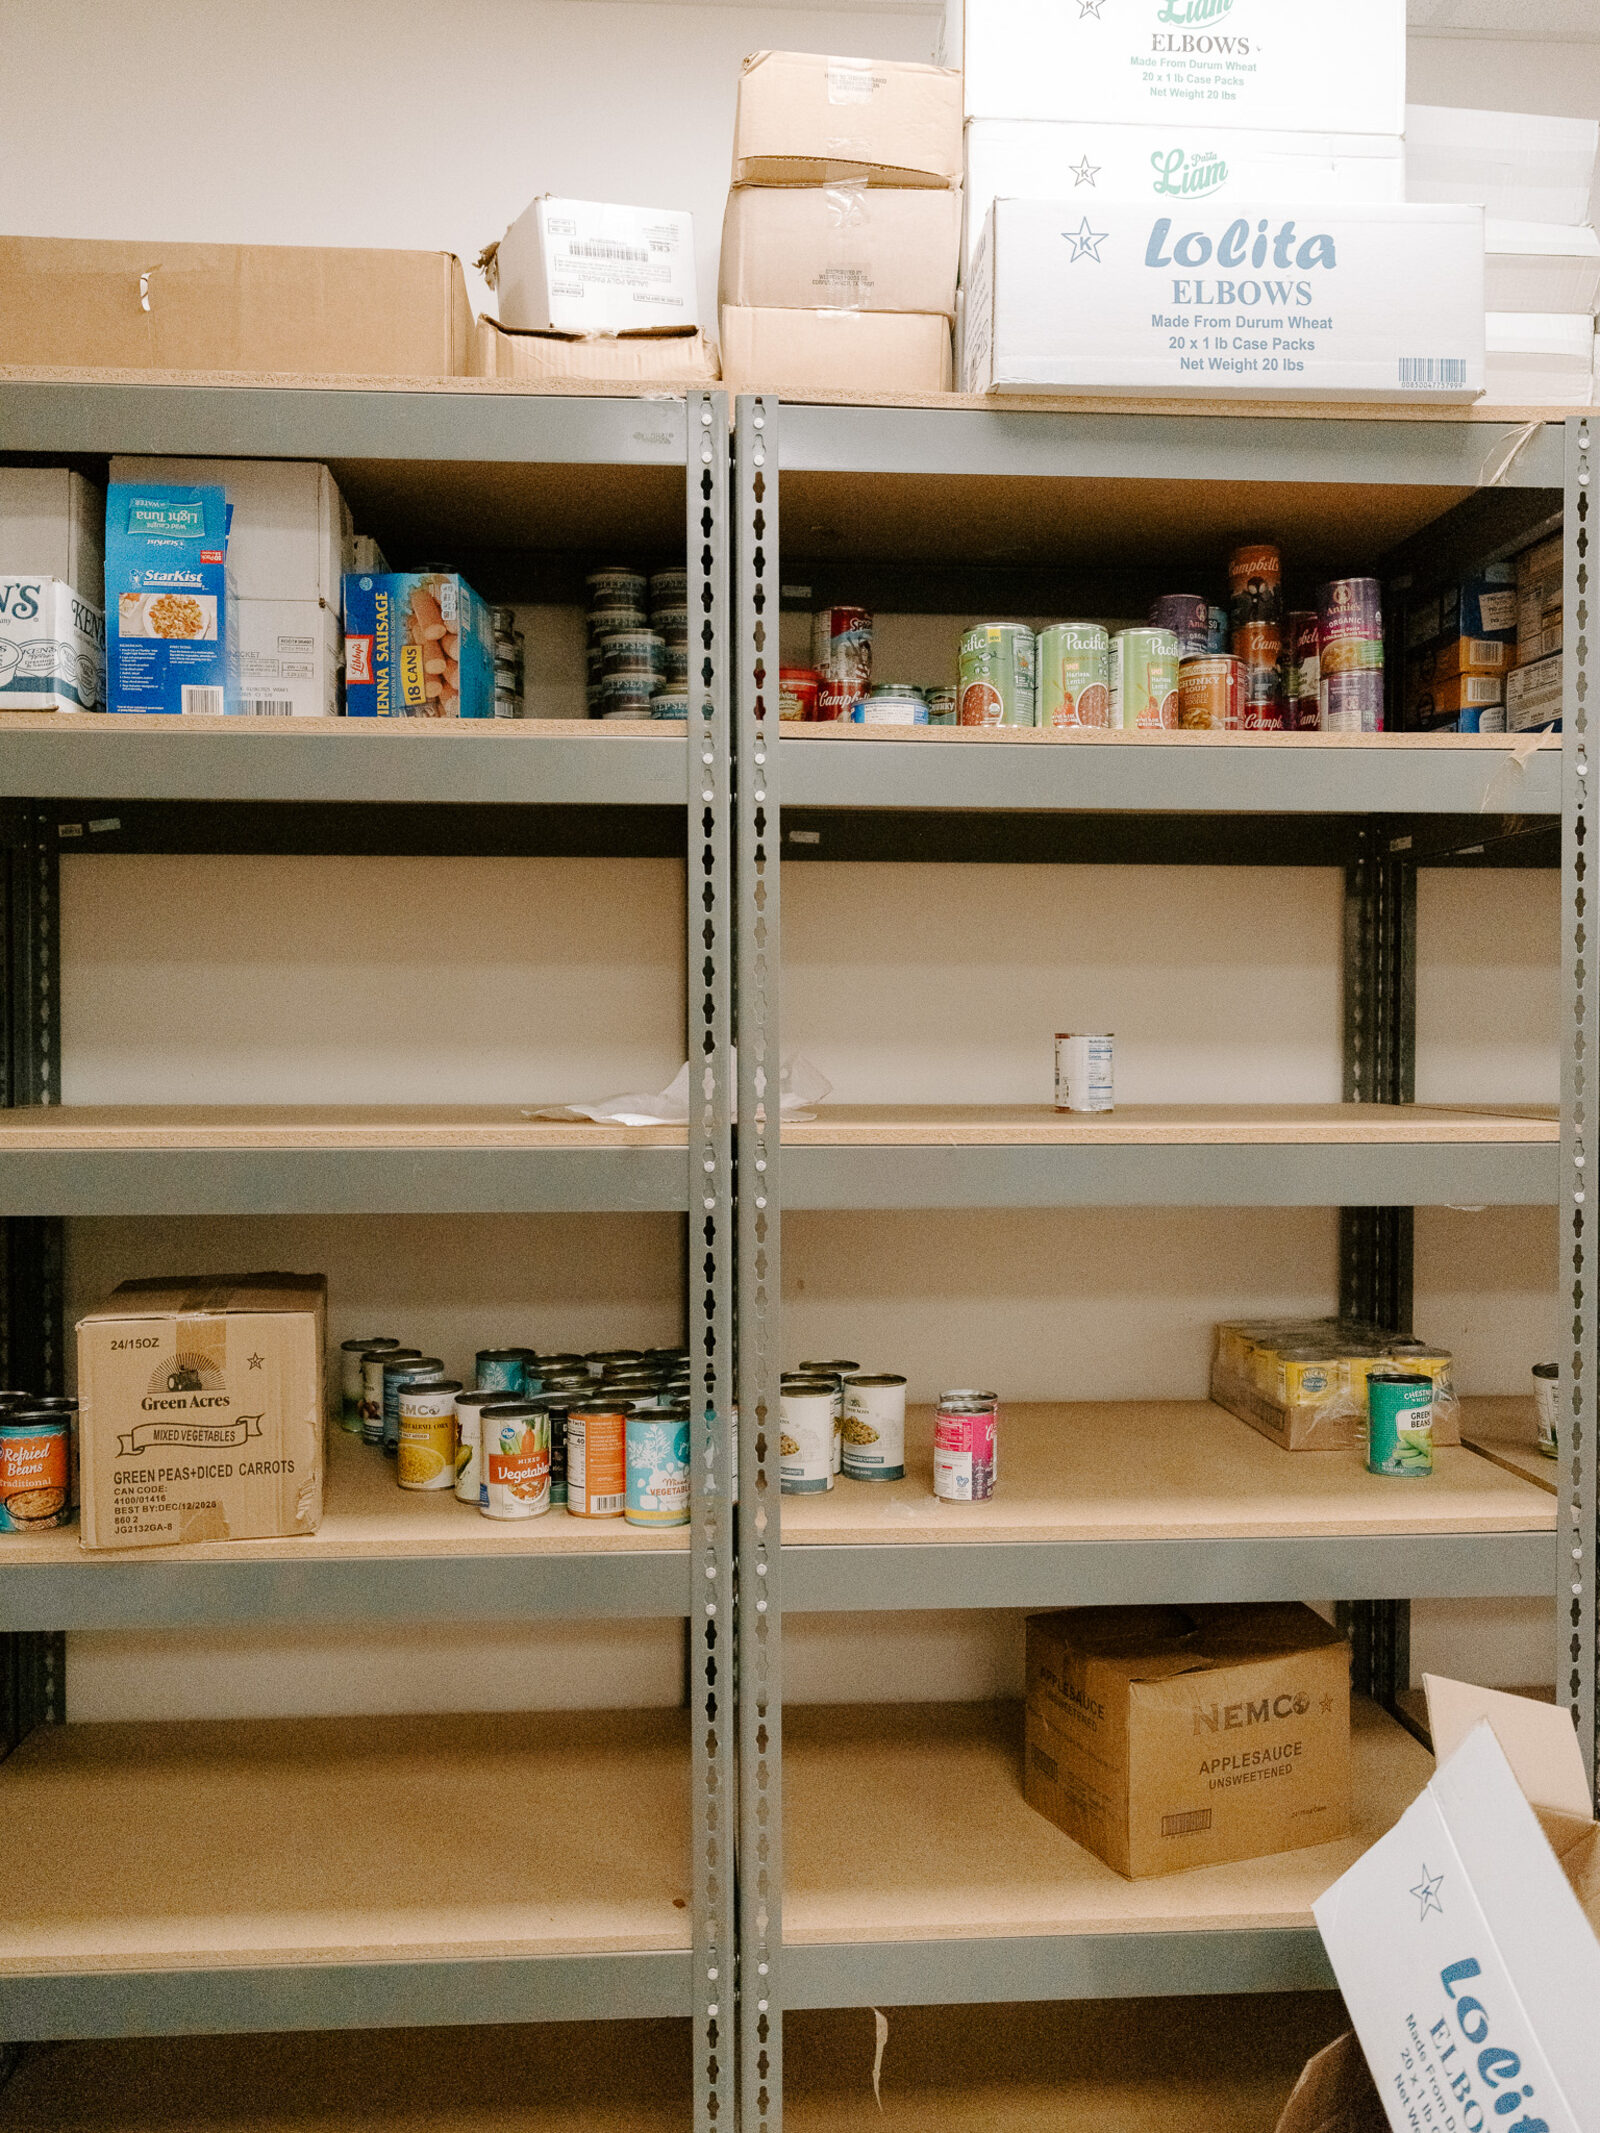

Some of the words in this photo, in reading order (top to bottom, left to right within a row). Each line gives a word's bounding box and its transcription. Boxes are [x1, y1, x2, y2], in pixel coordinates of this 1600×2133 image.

[1152, 33, 1250, 55] ELBOWS
[1130, 56, 1157, 67] Made
[1160, 57, 1186, 69] From
[1189, 59, 1223, 71] Durum
[1225, 61, 1257, 72] Wheat
[1142, 72, 1154, 82] 20
[1174, 73, 1184, 83] lb
[1186, 74, 1211, 85] Case
[1214, 76, 1245, 86] Packs
[1150, 87, 1167, 97] Net
[1169, 88, 1205, 101] Weight
[1207, 90, 1219, 100] 20
[1221, 90, 1236, 100] lbs
[1151, 148, 1229, 195] Liam
[1079, 236, 1093, 251] K
[1144, 218, 1337, 270] Lolita
[1171, 279, 1312, 306] ELBOWS
[1151, 314, 1189, 328] Made
[1194, 315, 1231, 328] From
[1236, 316, 1283, 329] Durum
[1288, 317, 1333, 329] Wheat
[1169, 336, 1185, 349] 20
[1190, 340, 1198, 349] x
[1203, 337, 1209, 349] 1
[1215, 337, 1227, 350] lb
[1232, 338, 1268, 350] Case
[1272, 338, 1315, 351] Packs
[1180, 357, 1204, 370] Net
[1208, 358, 1258, 374] Weight
[1262, 358, 1278, 371] 20
[1283, 358, 1304, 371] lbs
[136, 511, 166, 522] Tuna
[168, 510, 197, 523] Light
[145, 569, 203, 582] StarKist
[375, 591, 389, 661] SAUSAGE
[1328, 617, 1362, 628] ORGANIC
[1061, 631, 1107, 650] Pacific
[1147, 637, 1178, 656] Pacif
[350, 643, 366, 675] Libby's
[406, 648, 419, 683] CANS
[376, 667, 390, 717] IENNA
[407, 686, 421, 702] 18
[111, 1338, 159, 1350] 24/15OZ
[141, 1397, 187, 1411] Green
[189, 1395, 230, 1408] Acres
[1411, 1411, 1431, 1420] GREEN
[1411, 1419, 1431, 1428] BEANS
[433, 1421, 449, 1430] CORN
[153, 1429, 179, 1441] MIXED
[181, 1429, 236, 1442] VEGETABLES
[5, 1443, 50, 1465] Refried
[518, 1456, 540, 1464] MIXED
[8, 1463, 43, 1476] Beans
[114, 1469, 155, 1485] GREEN
[158, 1464, 233, 1482] PEAS+DICED
[239, 1460, 295, 1476] CARROTS
[498, 1462, 551, 1484] Vegetable
[114, 1487, 135, 1495] CAN
[137, 1485, 168, 1494] CODE:
[114, 1506, 139, 1515] BEST
[1040, 1666, 1105, 1720] APPLESAUCE
[1193, 1691, 1310, 1736] NEMCO
[1199, 1741, 1303, 1775] APPLESAUCE
[1208, 1763, 1293, 1790] UNSWEETENED
[1421, 1884, 1434, 1902] K
[1405, 2013, 1427, 2062] Made
[1426, 2064, 1447, 2114] From
[1393, 2073, 1411, 2108] Net
[1400, 2048, 1414, 2070] 20
[1410, 2075, 1418, 2085] x
[1417, 2089, 1426, 2100] 1
[1422, 2103, 1432, 2123] lb
